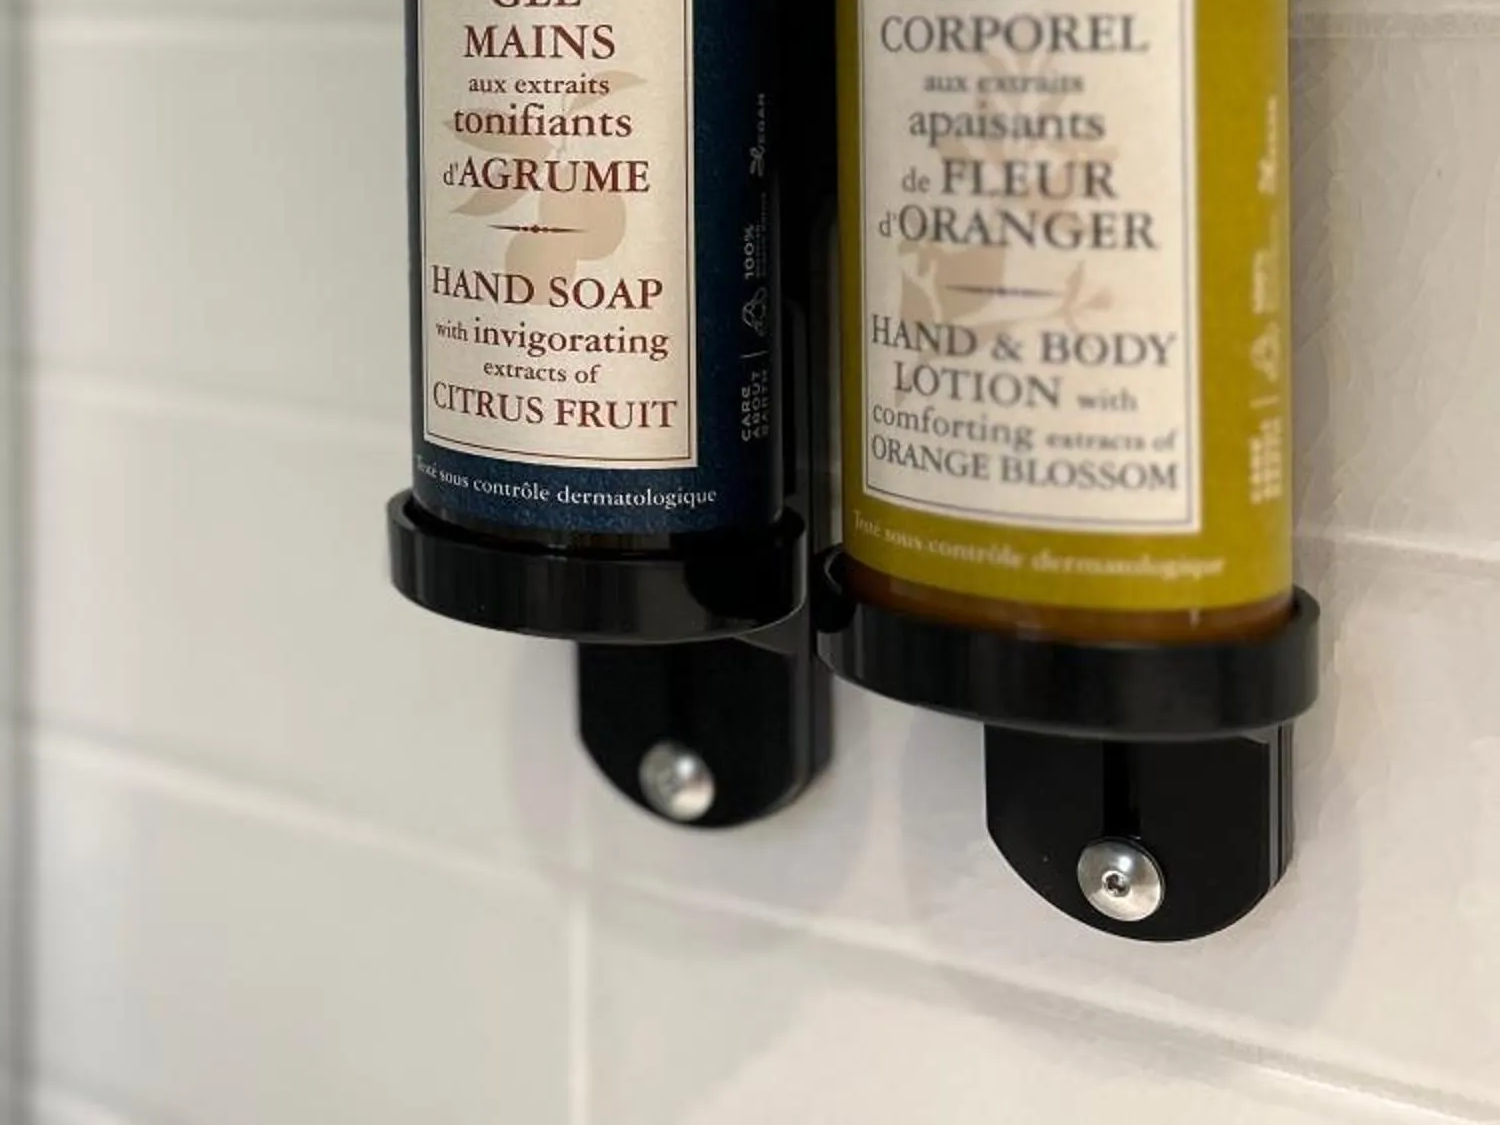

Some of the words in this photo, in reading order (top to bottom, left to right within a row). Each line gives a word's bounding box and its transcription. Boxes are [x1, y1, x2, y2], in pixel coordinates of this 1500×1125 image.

[464, 25, 615, 59] MAINS
[881, 14, 1150, 54] CORPOREL
[469, 77, 506, 94] aux
[515, 73, 610, 95] extraits
[923, 75, 968, 93] aux
[977, 71, 1085, 94] extraits
[454, 103, 633, 138] tonifiants
[909, 99, 1105, 147] apaisants
[444, 156, 650, 193] d'AGRUME
[902, 168, 930, 192] de
[942, 158, 1118, 200] FLEUR
[879, 205, 1157, 249] d'ORANGER
[744, 223, 755, 280] 100%
[432, 265, 535, 305] HAND
[549, 276, 663, 310] SOAP
[436, 320, 468, 342] with
[474, 317, 669, 360] invigorating
[872, 315, 977, 356] HAND
[991, 333, 1023, 362] &
[1041, 331, 1177, 366] BODY
[484, 361, 566, 383] extracts
[575, 365, 601, 384] of
[894, 363, 1060, 408] LOTION
[1078, 389, 1137, 411] with
[433, 381, 544, 424] CITRUS
[555, 399, 677, 430] FRUIT
[741, 386, 751, 442] CARE
[873, 404, 1034, 451] comforting
[1046, 431, 1145, 451] extracts
[1152, 430, 1177, 451] of
[872, 435, 991, 481] ORANGE
[1002, 460, 1177, 491] BLOSSOM
[440, 469, 468, 489] sous
[474, 475, 550, 502] contrôle
[557, 485, 717, 510] dermatologique
[884, 529, 922, 550] sous
